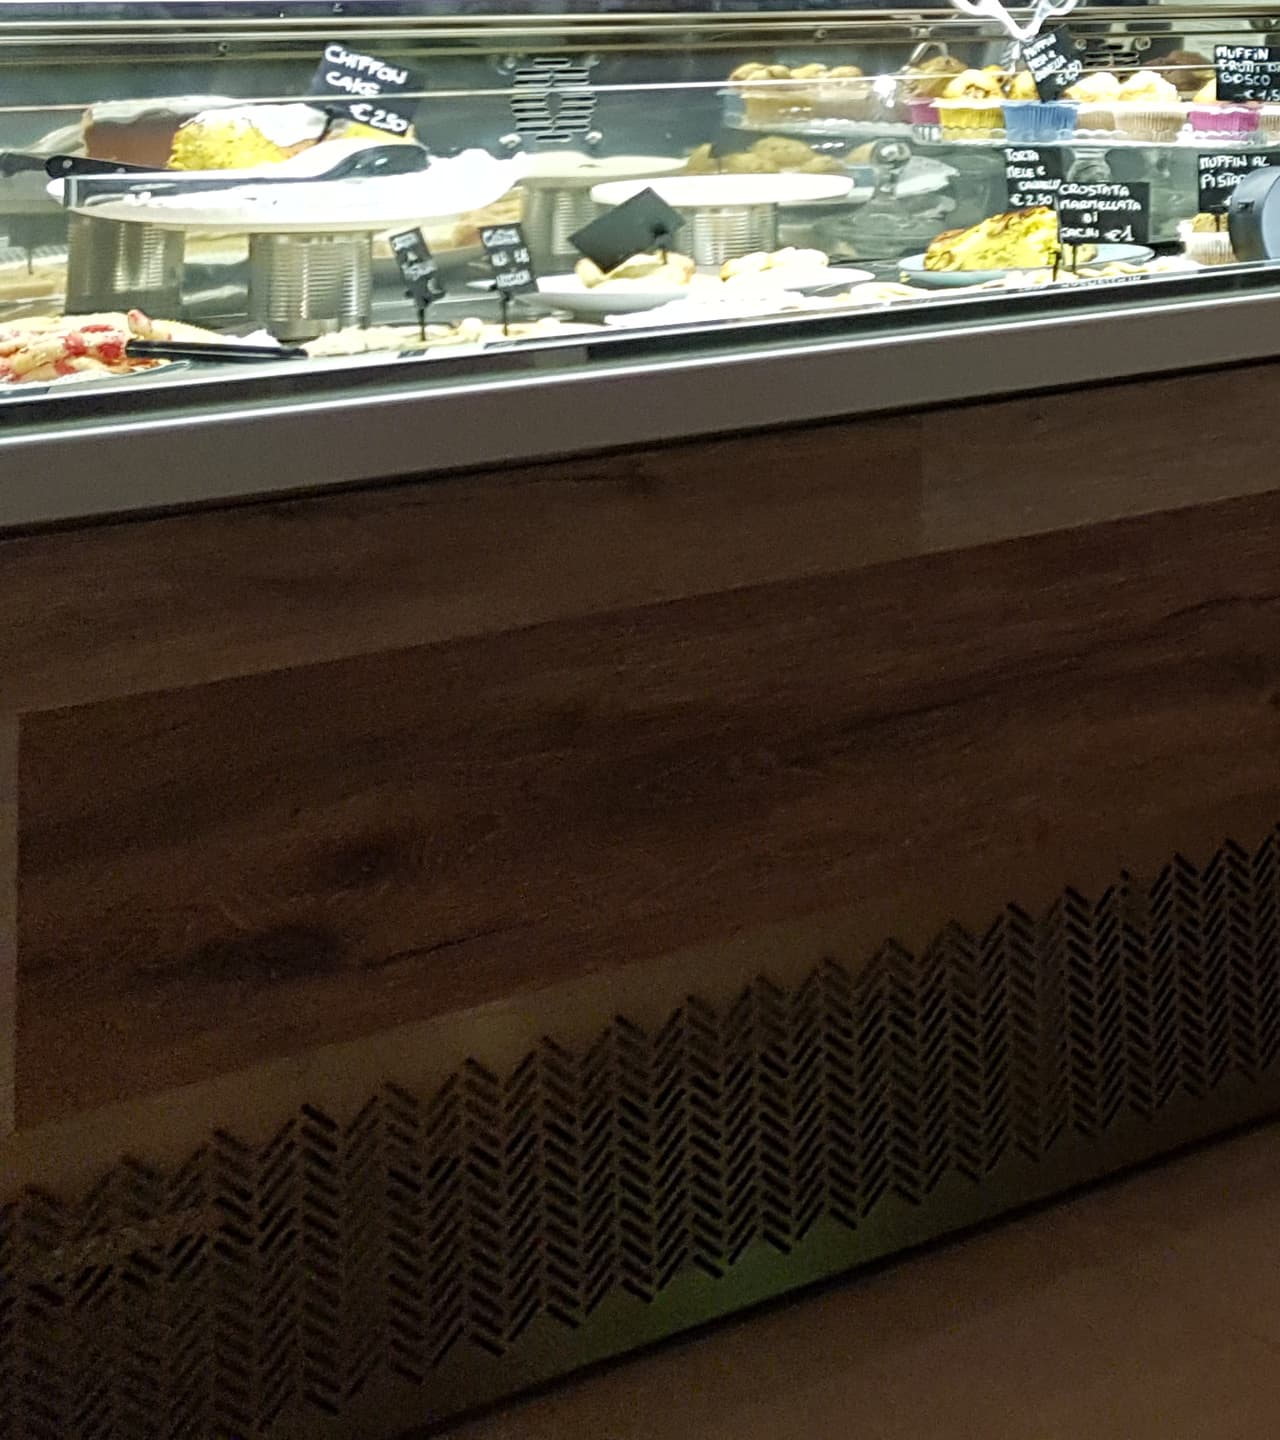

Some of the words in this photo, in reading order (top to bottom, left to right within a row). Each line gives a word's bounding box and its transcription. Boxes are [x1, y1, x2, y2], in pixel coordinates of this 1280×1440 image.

[1215, 45, 1269, 60] MUFFIN
[324, 45, 408, 85] CHIFFON
[325, 71, 381, 97] CAKE
[1220, 73, 1272, 87] BOSCO
[1004, 148, 1040, 161] TORTA
[1200, 156, 1248, 169] MUFFIN
[1253, 156, 1271, 167] AL
[1059, 184, 1130, 197] CROSTATA
[1059, 199, 1142, 211] MARMELLATA
